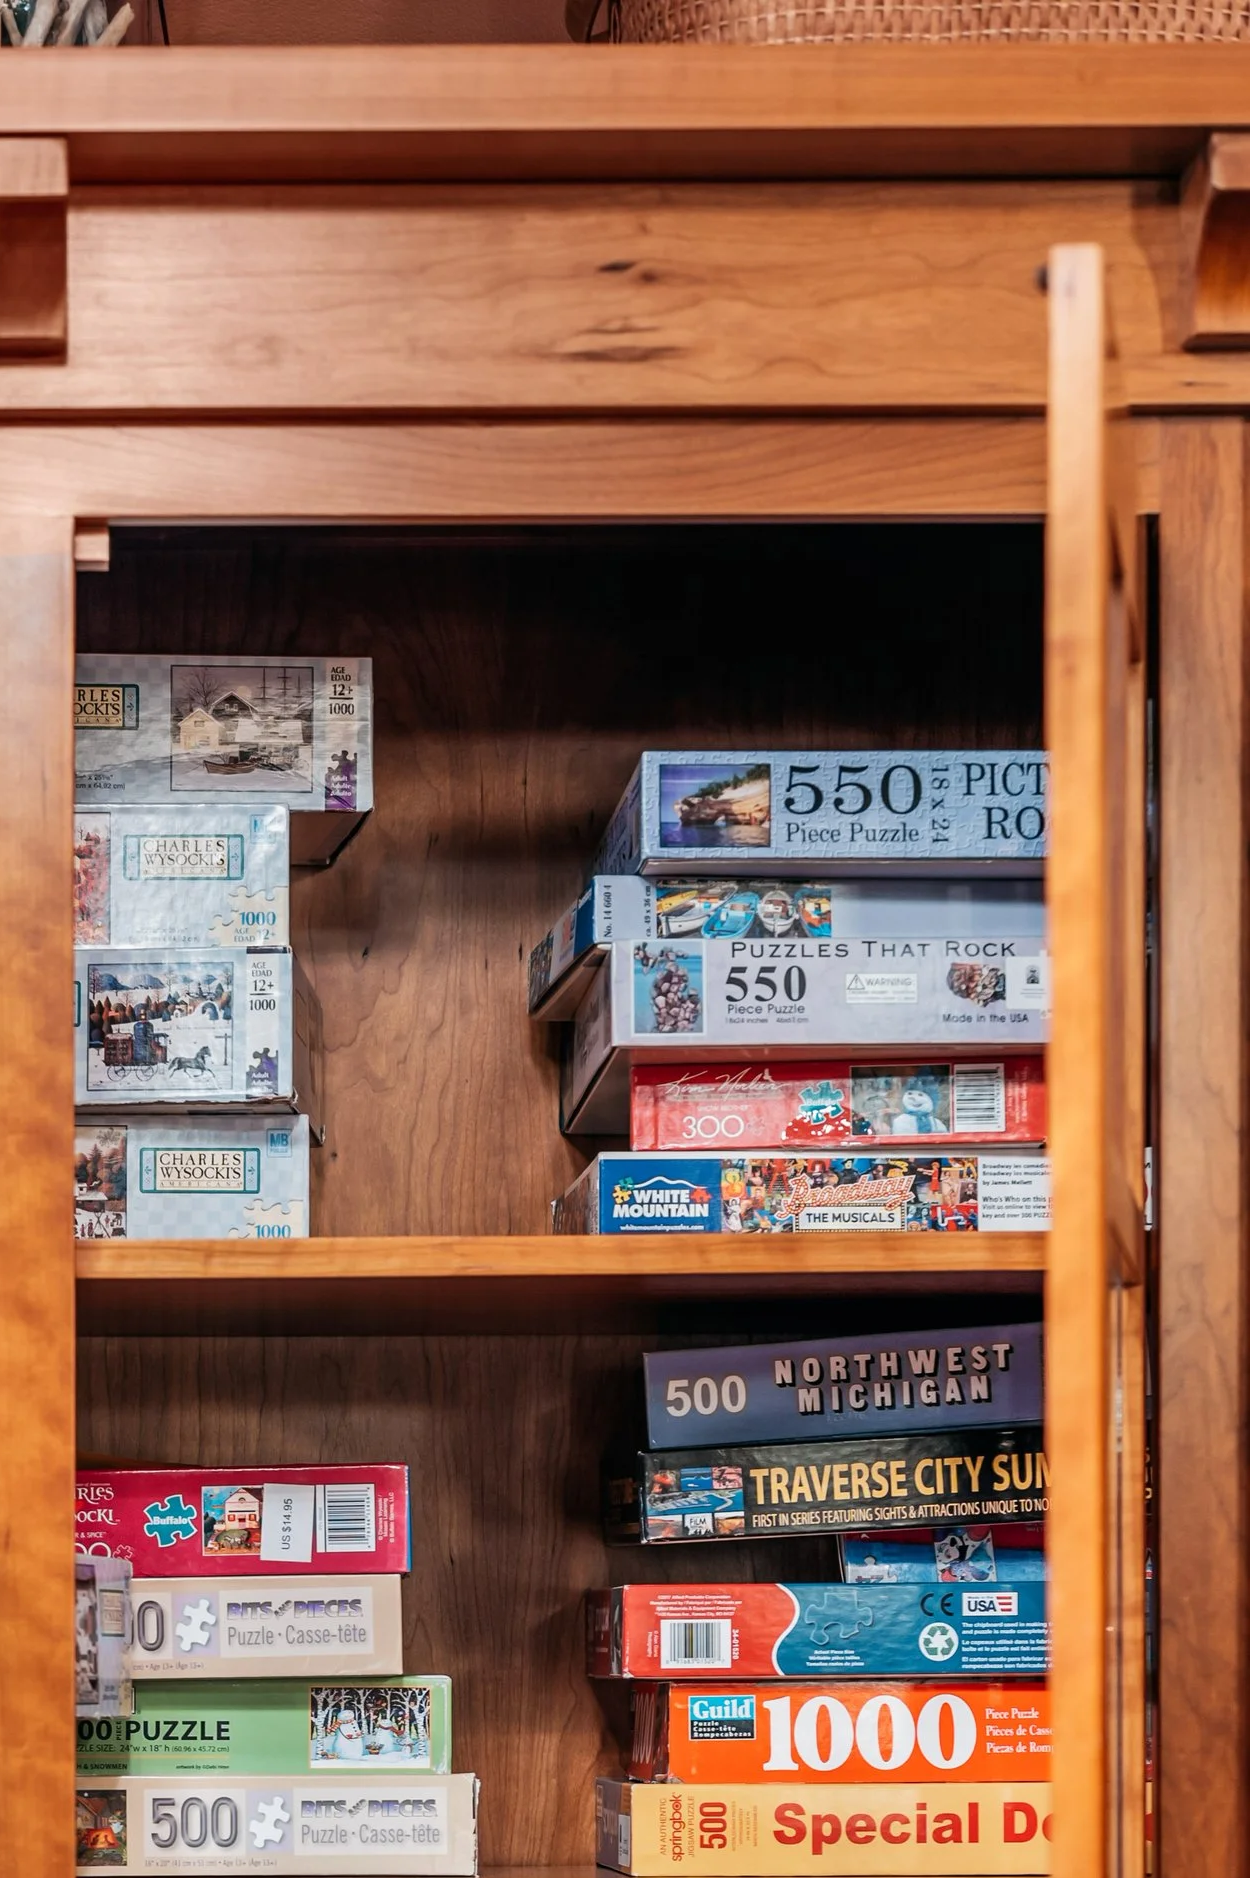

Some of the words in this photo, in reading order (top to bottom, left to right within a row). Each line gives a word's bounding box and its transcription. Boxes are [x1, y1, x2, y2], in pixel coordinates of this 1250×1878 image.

[331, 666, 346, 674] AGE
[328, 703, 354, 715] 1000
[784, 765, 922, 814] 550
[786, 822, 841, 842] Piece
[850, 822, 919, 843] Puzzle
[143, 840, 224, 852] CHARLES
[240, 911, 276, 925] 1000
[731, 942, 849, 958] PUZZLES
[862, 941, 931, 957] THAT
[946, 941, 1015, 957] ROCK
[253, 980, 274, 991] 12+
[725, 966, 806, 1002] 550
[250, 999, 276, 1011] 1000
[727, 1004, 763, 1014] Piece
[767, 1004, 805, 1014] Puzzle
[682, 1115, 744, 1139] 300
[160, 1152, 241, 1166] CHARLES
[161, 1167, 241, 1180] WYSOCKI'S
[632, 1190, 690, 1203] WHITE
[775, 1173, 916, 1219] Broadway
[612, 1203, 708, 1218] MOUNTAIN
[806, 1213, 828, 1223] THE
[832, 1211, 895, 1223] MUSICALS
[774, 1343, 1013, 1389] NORTHWEST
[666, 1375, 746, 1418] 500
[798, 1374, 993, 1415] MICHIGAN
[154, 1516, 188, 1525] Buffalo
[281, 1499, 292, 1530] $14.95
[281, 1534, 292, 1550] US
[227, 1602, 272, 1620] BITS
[274, 1600, 292, 1618] AND
[294, 1599, 362, 1618] PIECES
[968, 1601, 996, 1612] USA
[228, 1625, 273, 1646] Puzzle
[285, 1621, 366, 1644] Casse-tête
[692, 1699, 752, 1720] Guild
[985, 1709, 1008, 1719] Piece
[1011, 1709, 1039, 1719] Puzzle
[762, 1694, 977, 1772] 1000
[151, 1797, 239, 1848] 500
[672, 1792, 683, 1861] springbok
[700, 1802, 727, 1850] 500
[302, 1824, 348, 1845] Puzzle
[360, 1821, 440, 1844] Casse-tête
